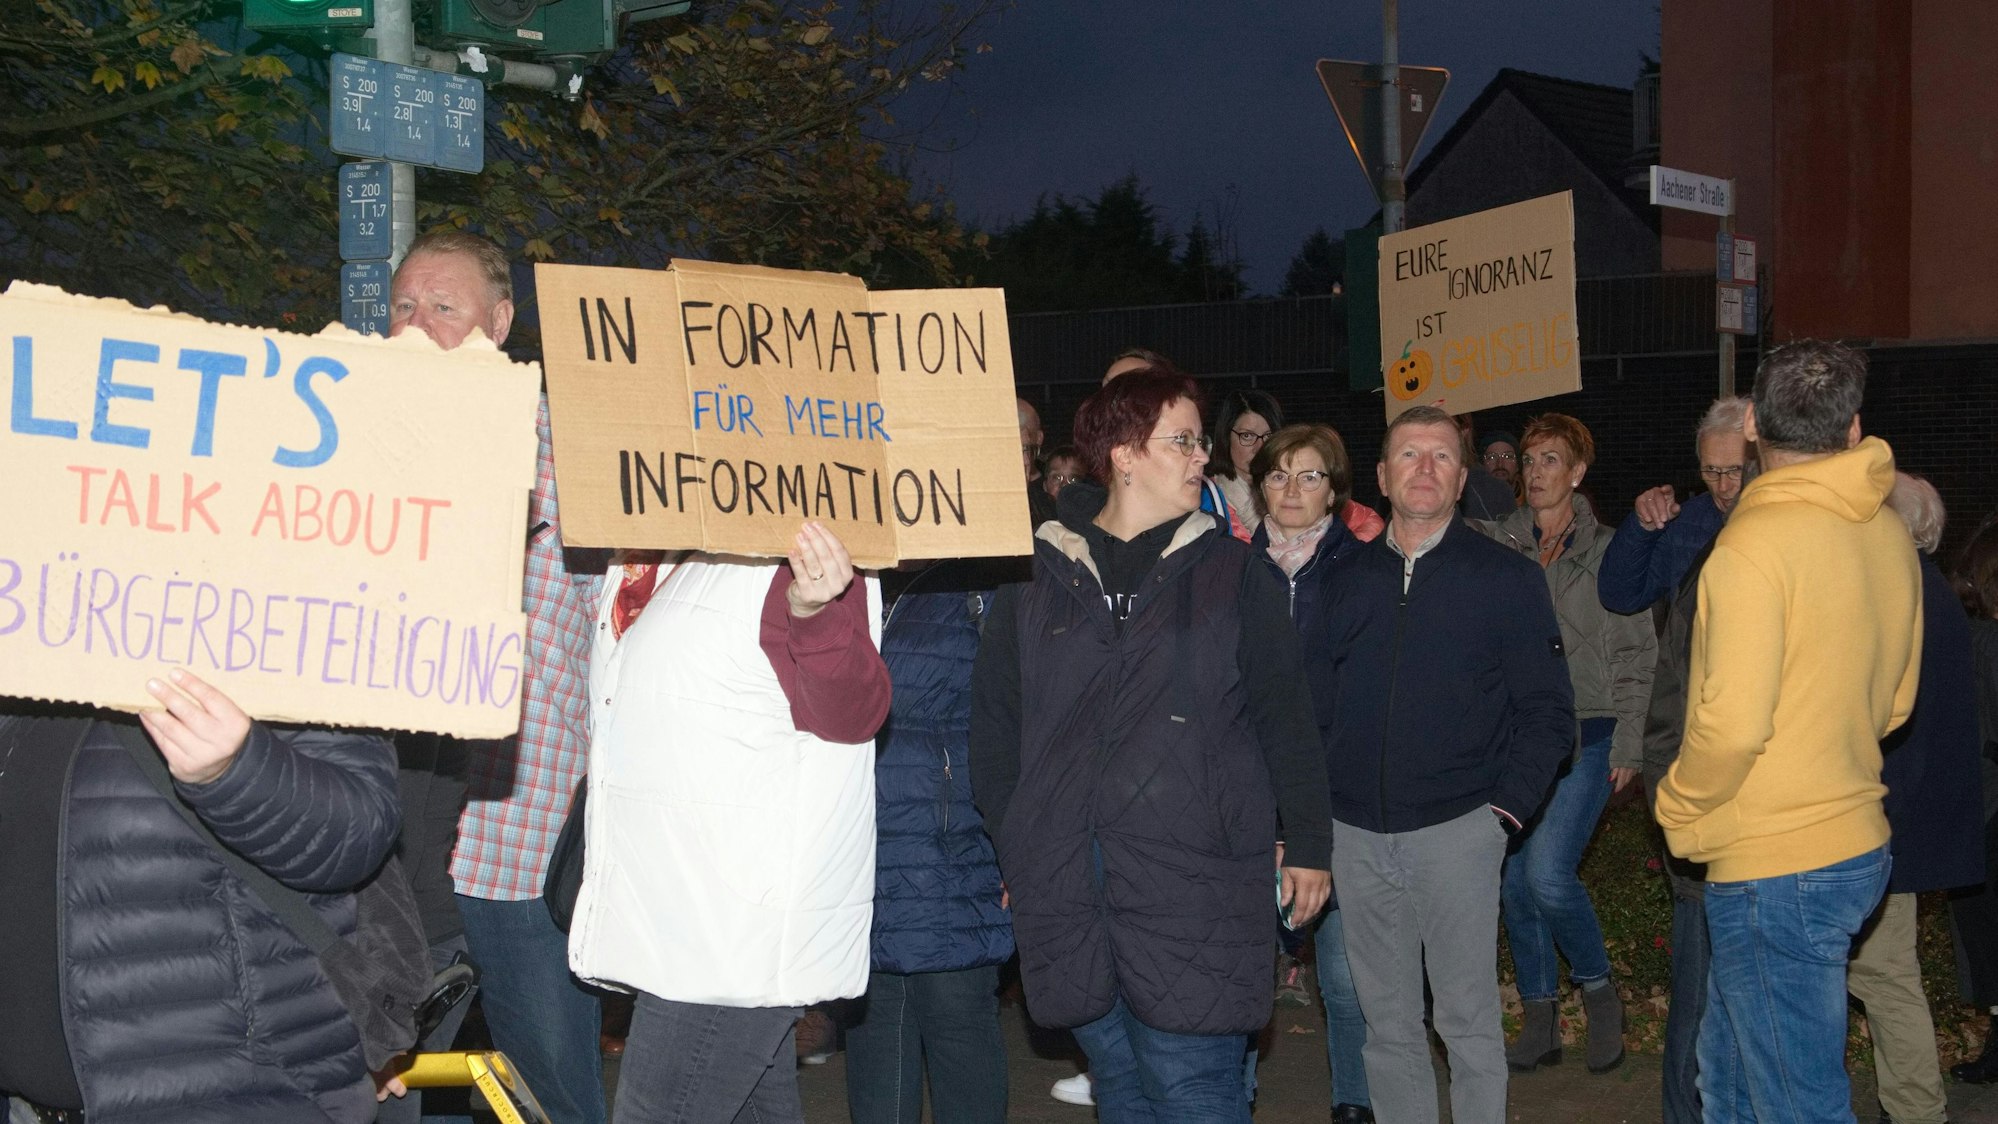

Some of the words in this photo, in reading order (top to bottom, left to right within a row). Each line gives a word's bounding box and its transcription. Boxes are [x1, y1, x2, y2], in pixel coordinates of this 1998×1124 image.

[343, 76, 349, 88] S
[358, 79, 378, 94] 200
[394, 85, 401, 98] S
[415, 88, 434, 104] 200
[444, 94, 450, 107] S
[458, 96, 477, 111] 200
[346, 185, 353, 198] S
[361, 183, 380, 197] 200
[1661, 174, 1697, 202] Aachener
[1700, 182, 1725, 208] Straße
[1396, 239, 1448, 282] EURE
[1448, 248, 1553, 300] IGNORANZ
[348, 284, 354, 297] S
[362, 283, 380, 297] 200
[578, 296, 637, 364] IN
[680, 300, 987, 375] FORMATION
[1416, 311, 1447, 339] IST
[1440, 312, 1572, 389] GRUSELIG
[11, 336, 350, 468] LET'S
[694, 384, 763, 438] FÜR
[785, 395, 892, 443] MEHR
[619, 450, 967, 527] INFORMATION
[66, 465, 223, 535] TALK
[251, 482, 452, 562] ABOUT
